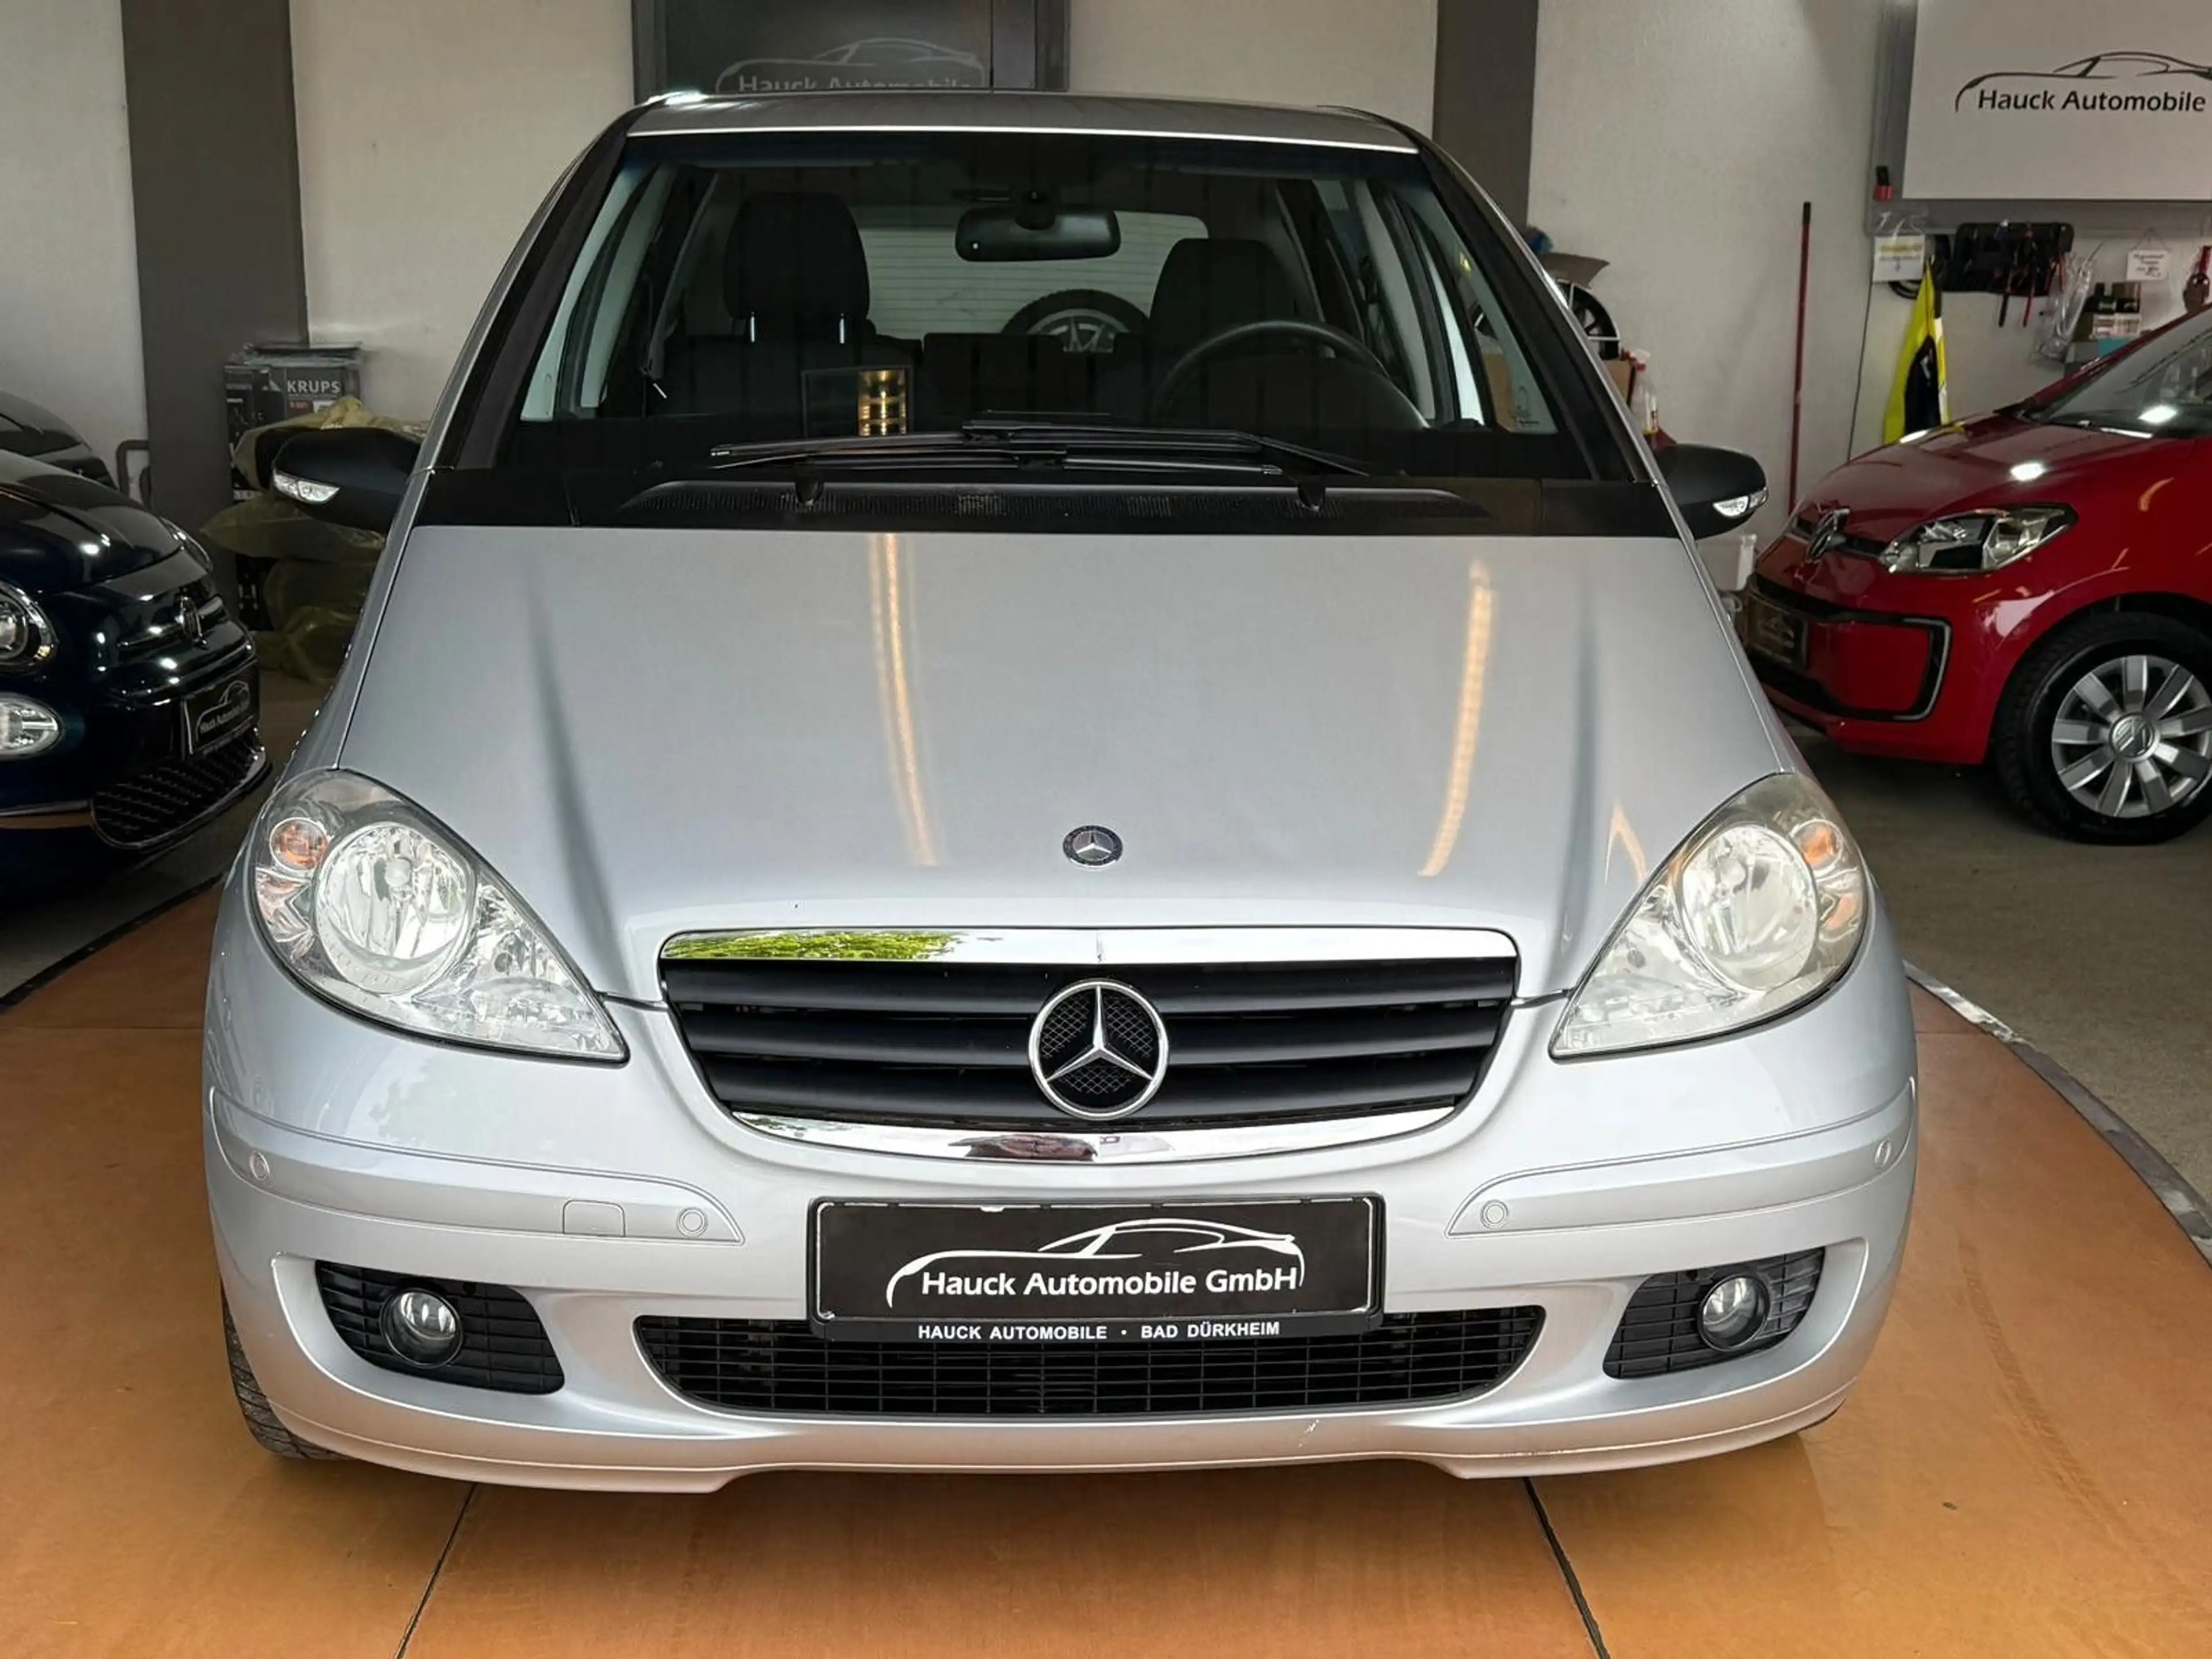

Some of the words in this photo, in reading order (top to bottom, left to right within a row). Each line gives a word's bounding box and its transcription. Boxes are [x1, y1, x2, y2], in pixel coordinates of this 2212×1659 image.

[738, 74, 817, 91] Hauck
[1978, 89, 2055, 110] Hauck
[2061, 90, 2206, 112] Automobile
[287, 380, 341, 393] KRUPS
[922, 1271, 1016, 1295] Hauck
[1022, 1271, 1197, 1295] Automobile
[1205, 1267, 1297, 1293] GmbH
[918, 1325, 982, 1339] HAUCK
[989, 1325, 1108, 1340] AUTOMOBILE
[1141, 1325, 1179, 1339] BAD
[1187, 1321, 1281, 1338] DÜRKHEIM
